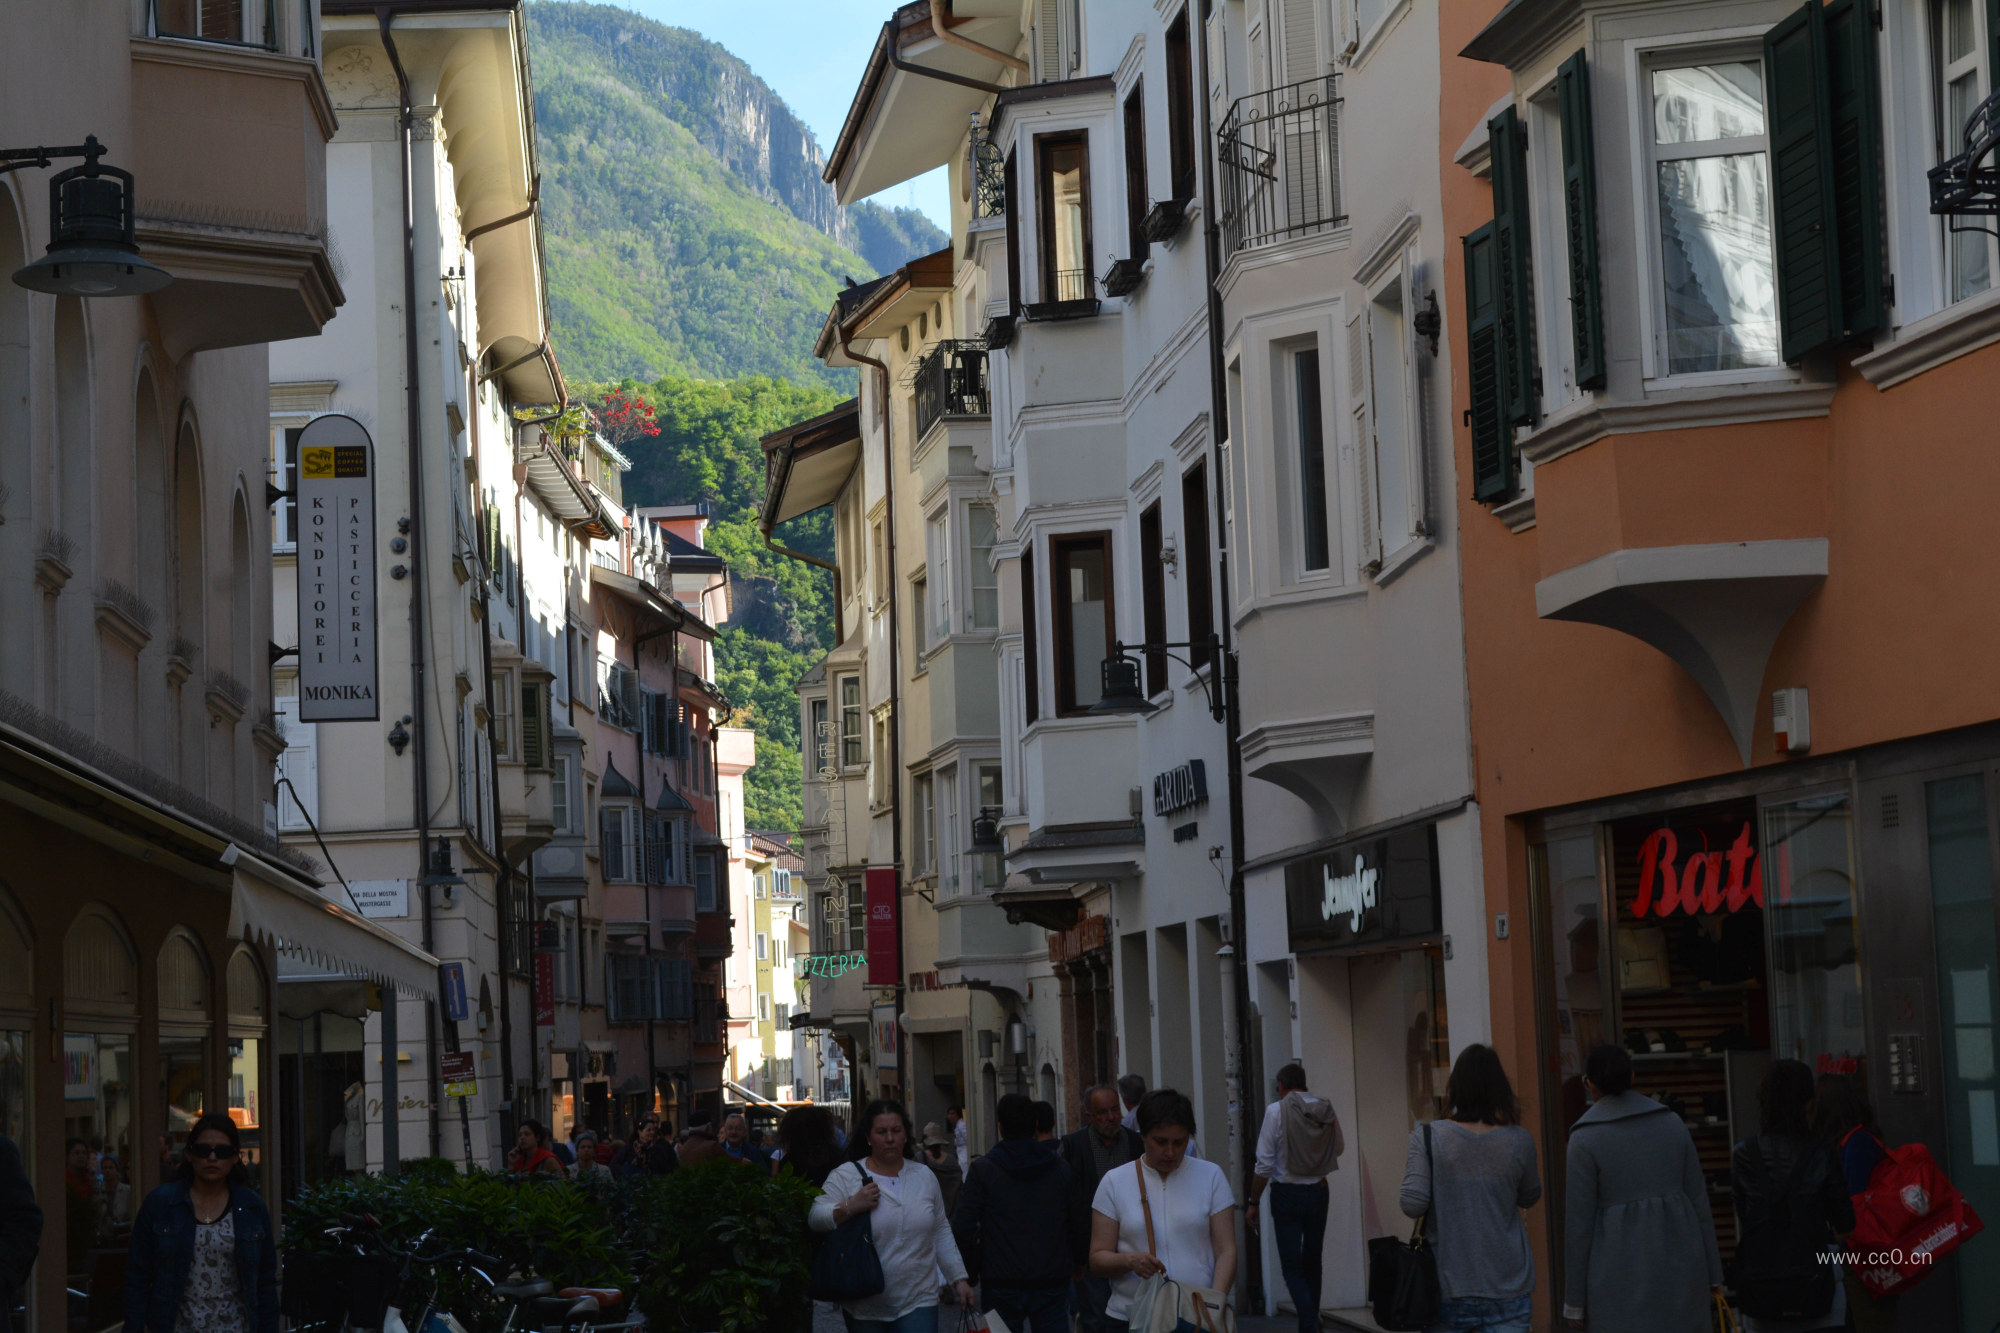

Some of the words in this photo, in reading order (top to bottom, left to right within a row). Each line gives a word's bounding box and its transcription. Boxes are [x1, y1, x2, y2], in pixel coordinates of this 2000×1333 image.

[312, 497, 325, 664] KONDITOREI
[350, 497, 362, 664] PASTICCERIA
[304, 684, 373, 702] MONIKA
[1153, 761, 1200, 817] GARUDA
[818, 721, 847, 936] RESTAURANT
[1895, 994, 1914, 1022] 18
[1815, 1052, 1857, 1074] Bata
